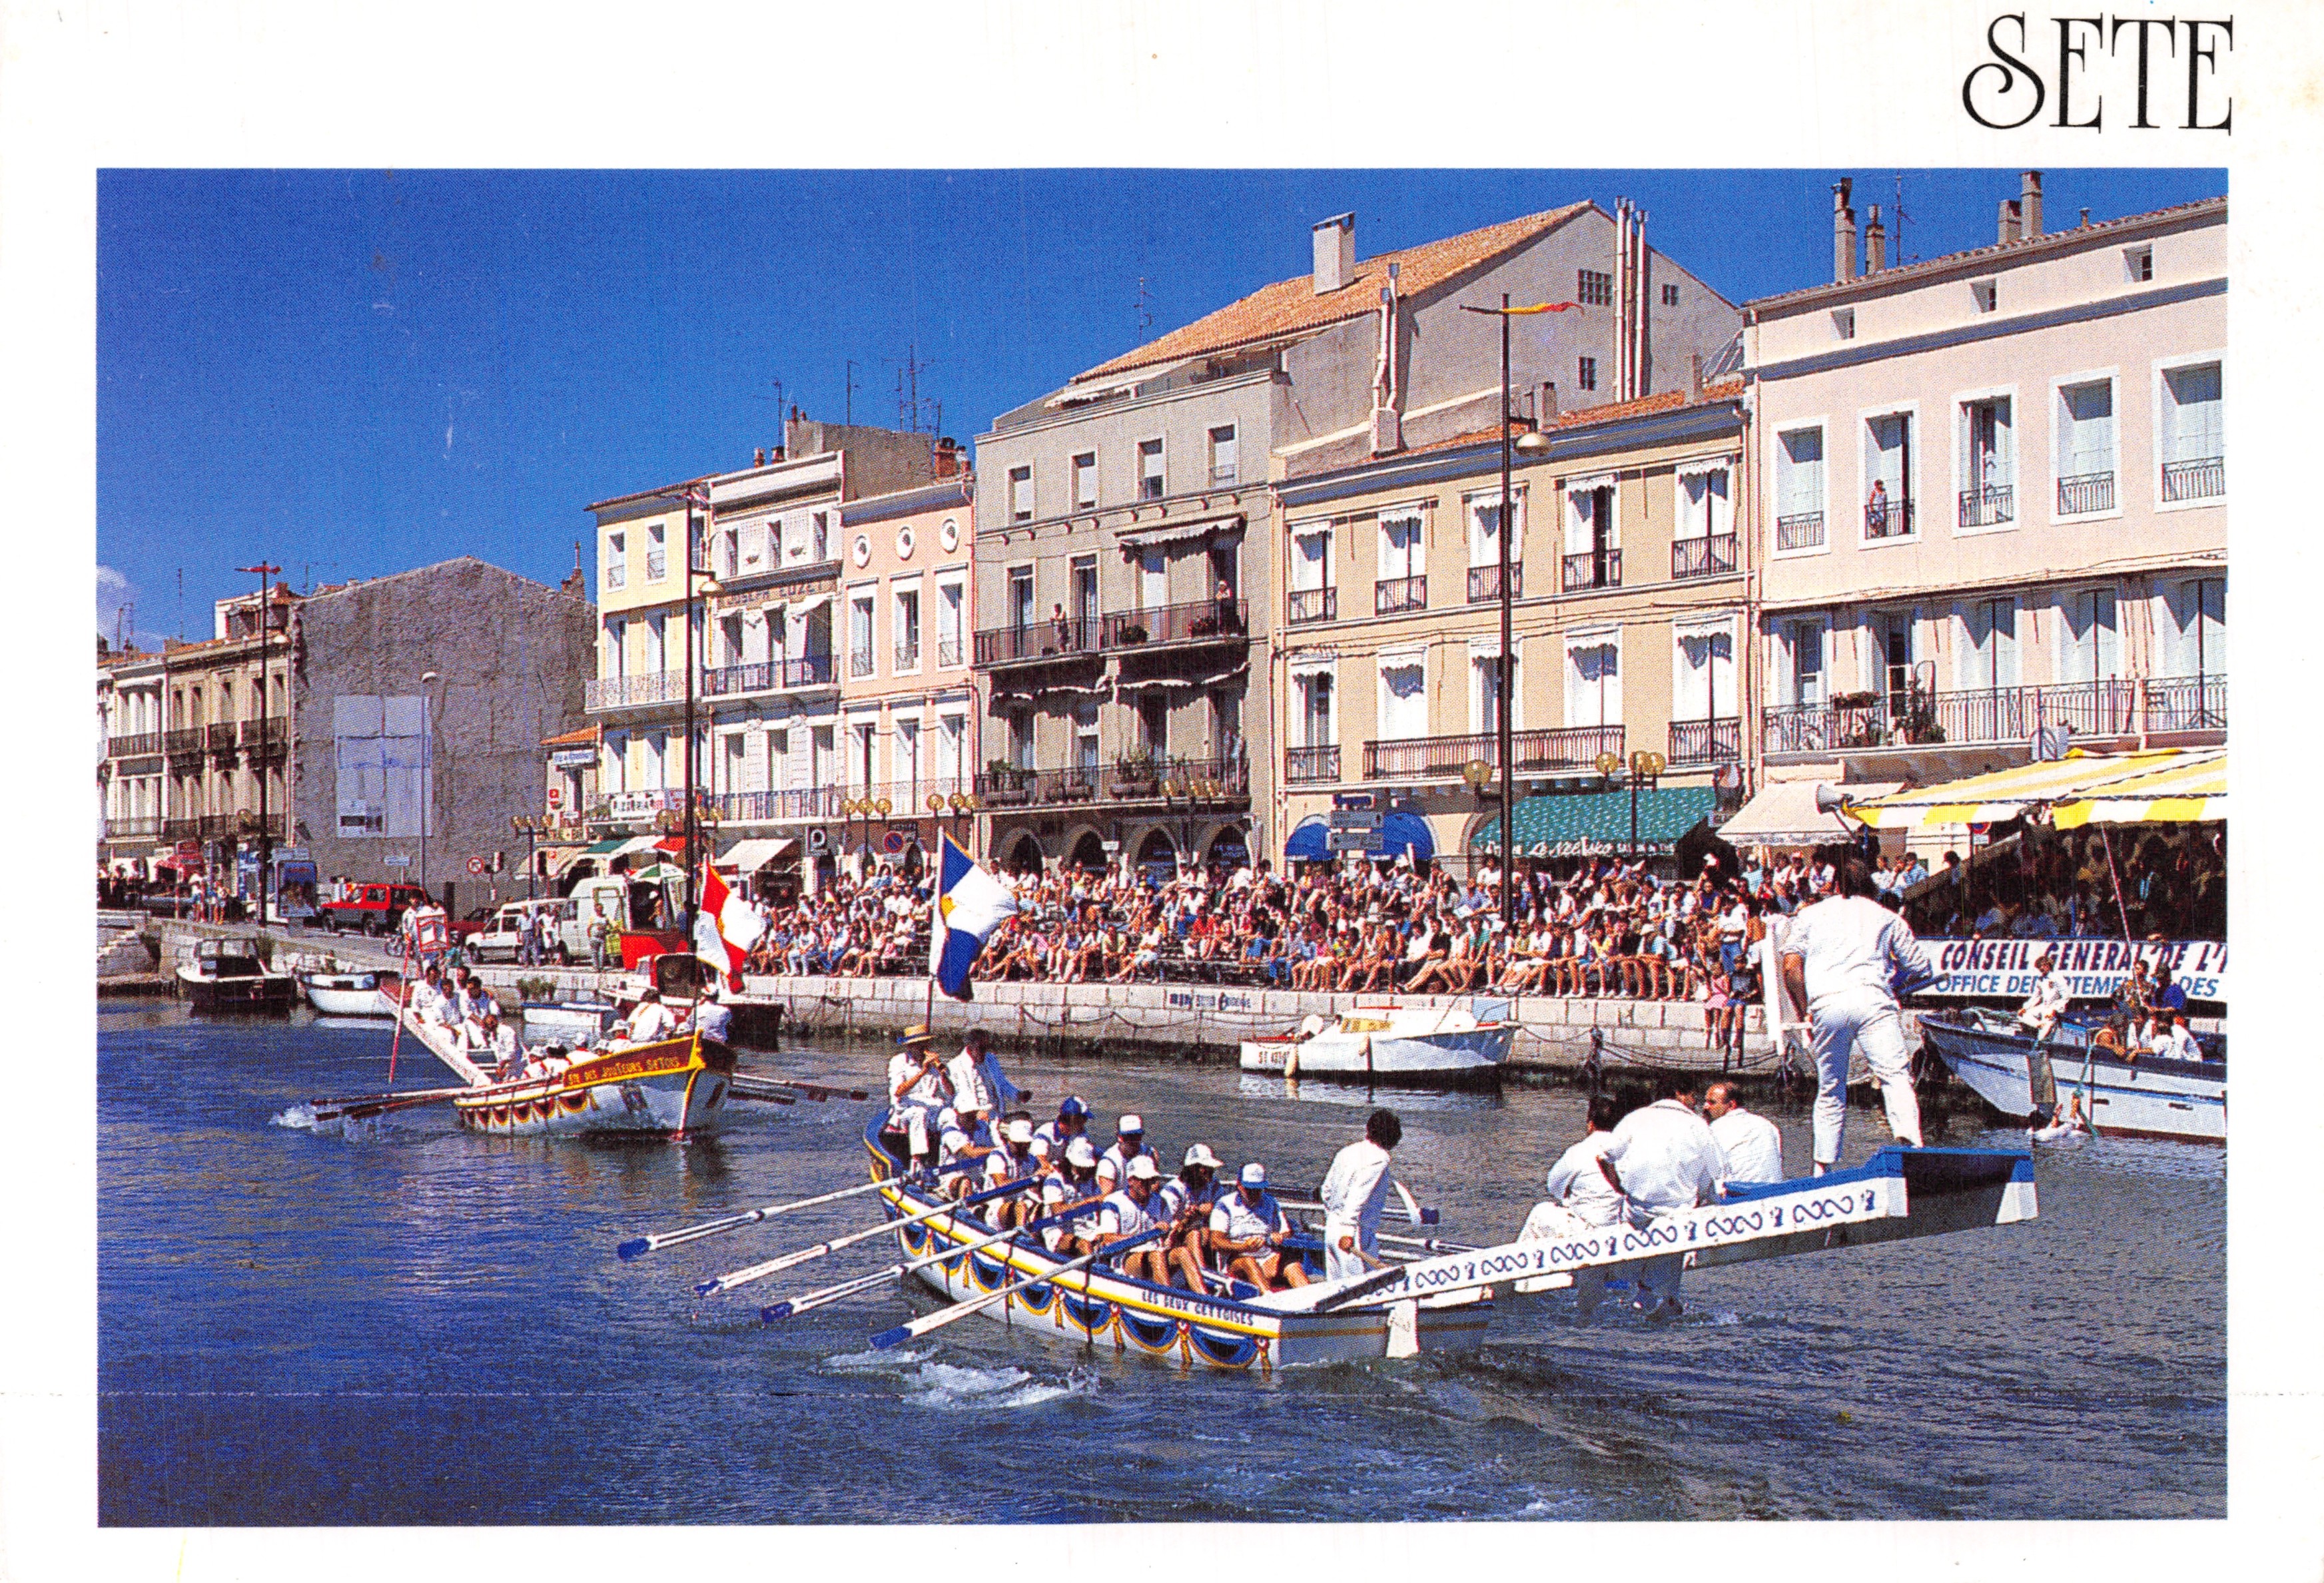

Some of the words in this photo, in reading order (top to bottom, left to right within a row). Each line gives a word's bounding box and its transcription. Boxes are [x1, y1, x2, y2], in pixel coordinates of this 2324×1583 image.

[1941, 942, 2029, 970] CONSEIL
[1935, 974, 2001, 993] OFFICE
[2179, 975, 2219, 998] DES
[1142, 1289, 1158, 1305] LES
[1164, 1293, 1189, 1311] DEUX
